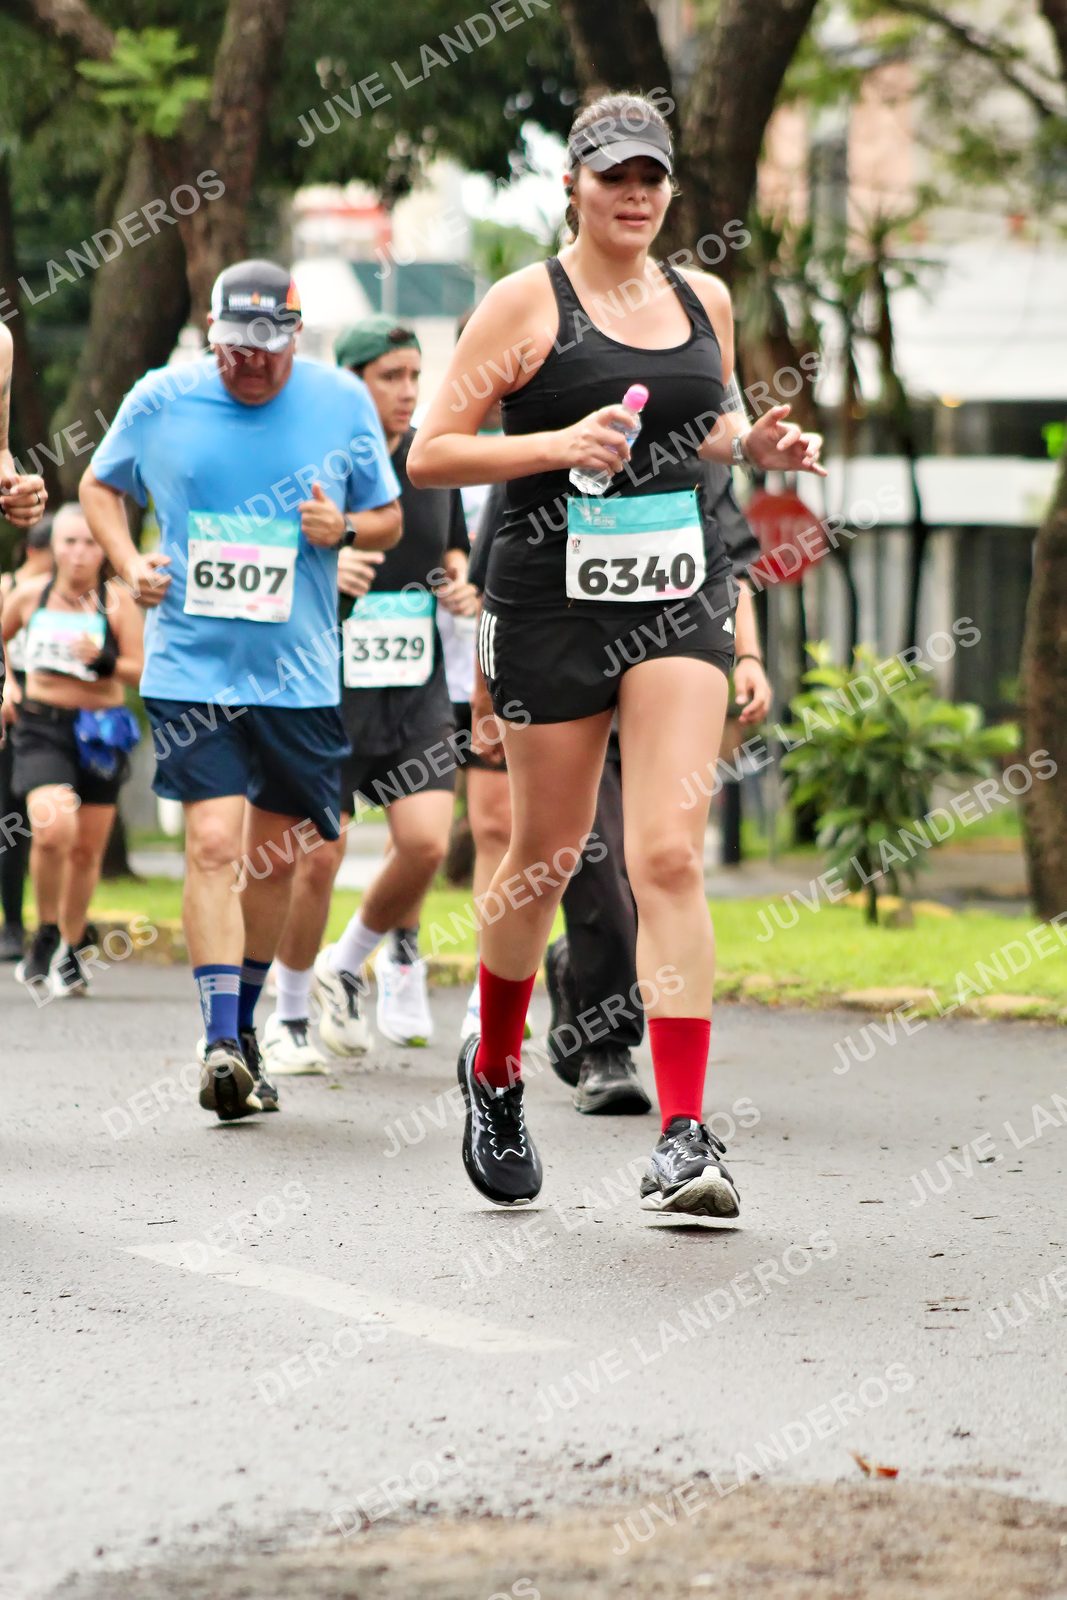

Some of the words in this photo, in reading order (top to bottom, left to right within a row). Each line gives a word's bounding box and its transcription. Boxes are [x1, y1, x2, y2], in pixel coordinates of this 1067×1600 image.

[193, 561, 288, 595] 6307
[578, 553, 696, 596] 6340
[351, 636, 425, 661] 3329
